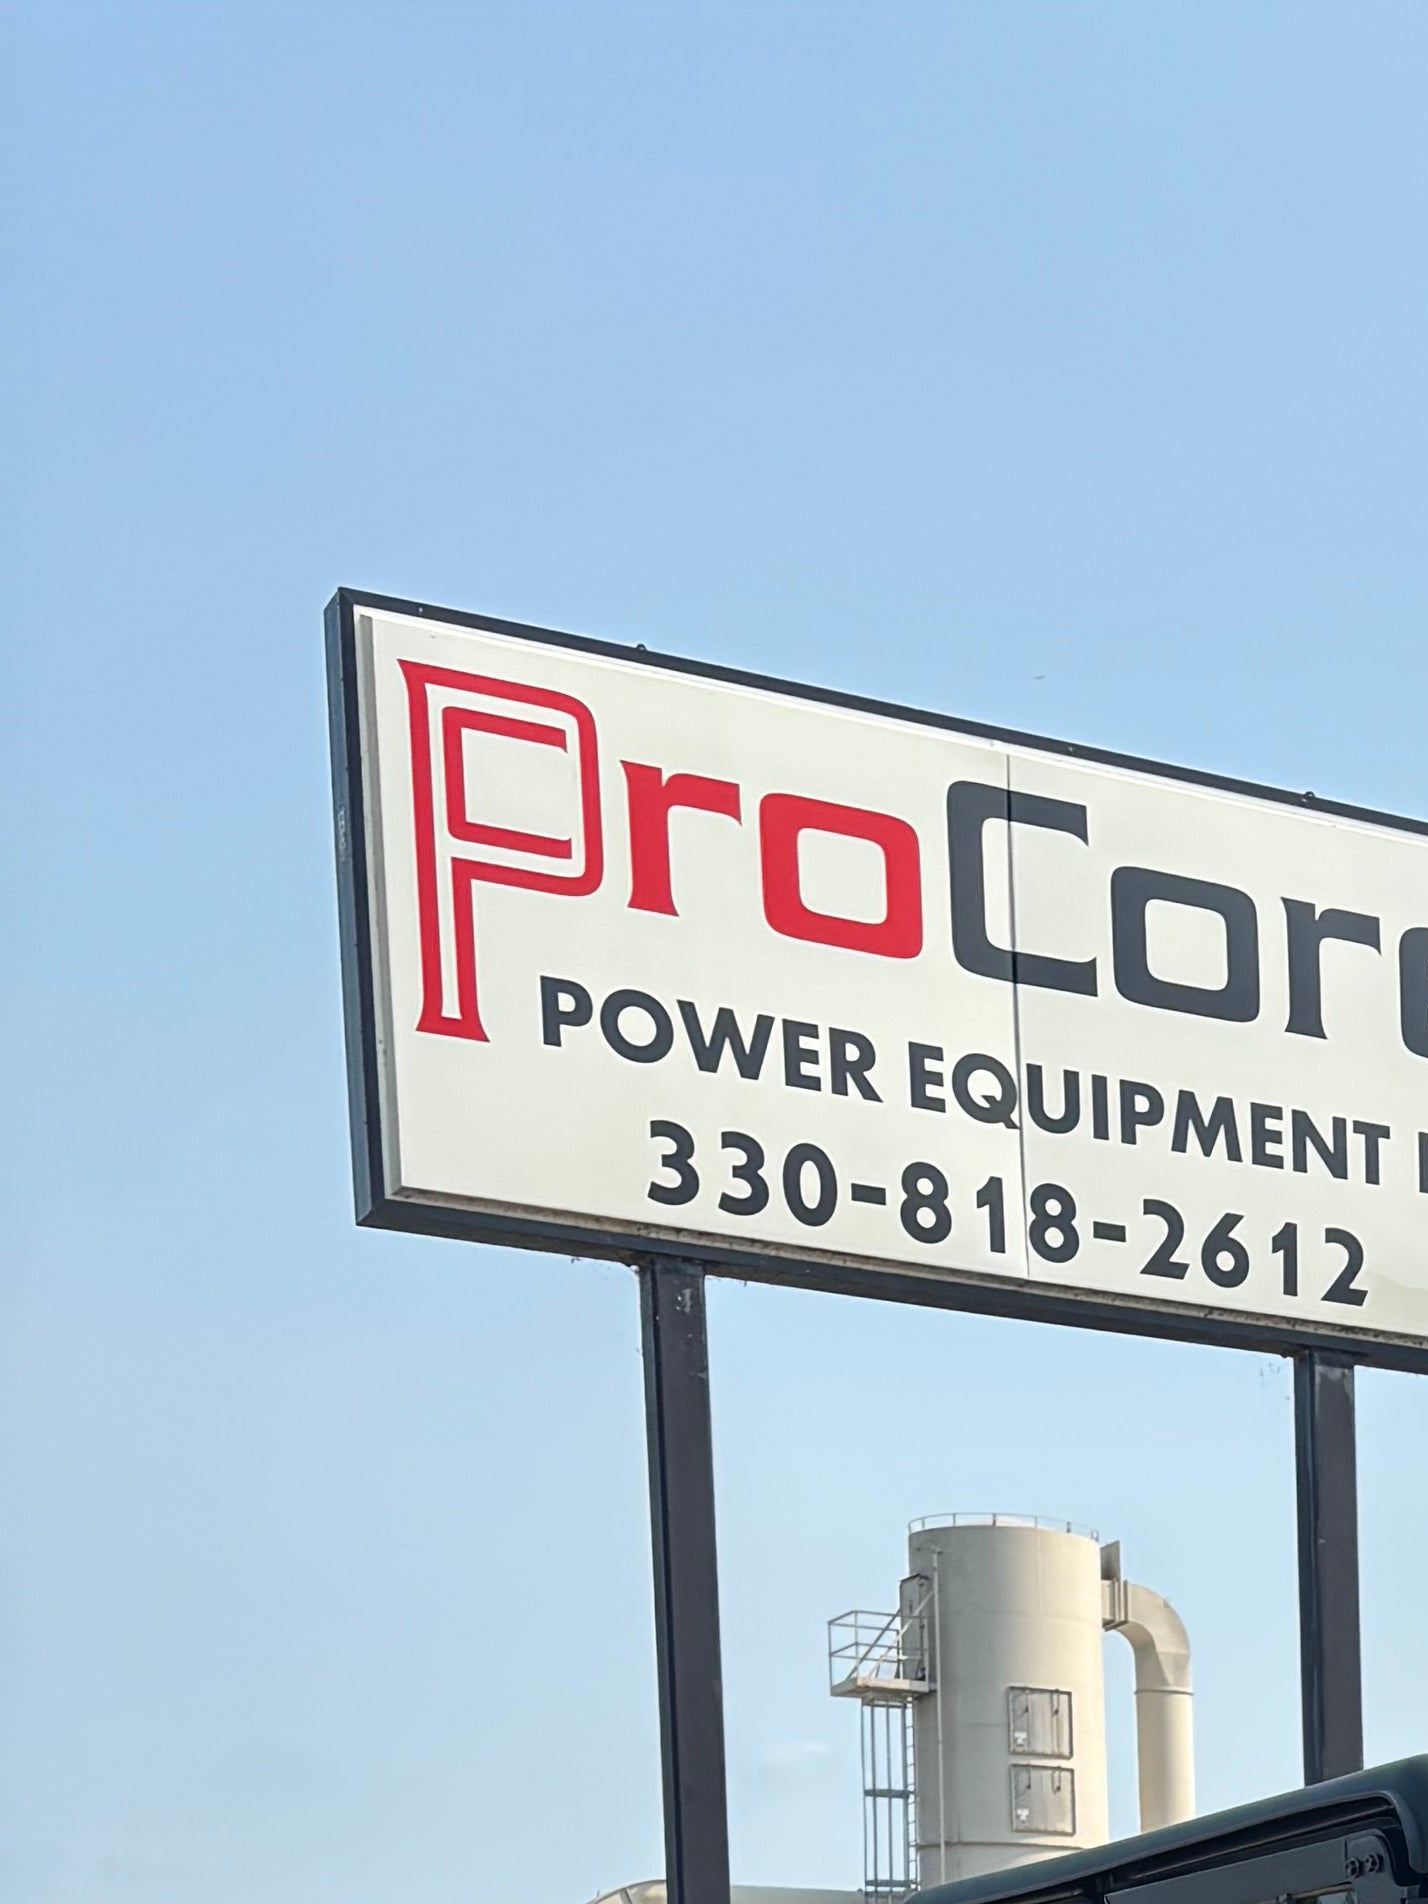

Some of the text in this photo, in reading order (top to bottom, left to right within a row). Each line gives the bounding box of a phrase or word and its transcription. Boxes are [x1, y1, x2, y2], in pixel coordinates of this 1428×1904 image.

[540, 975, 884, 1103] POWER
[908, 1041, 1390, 1186] EQUIPMENT
[647, 1120, 1368, 1306] 330-818-2612
